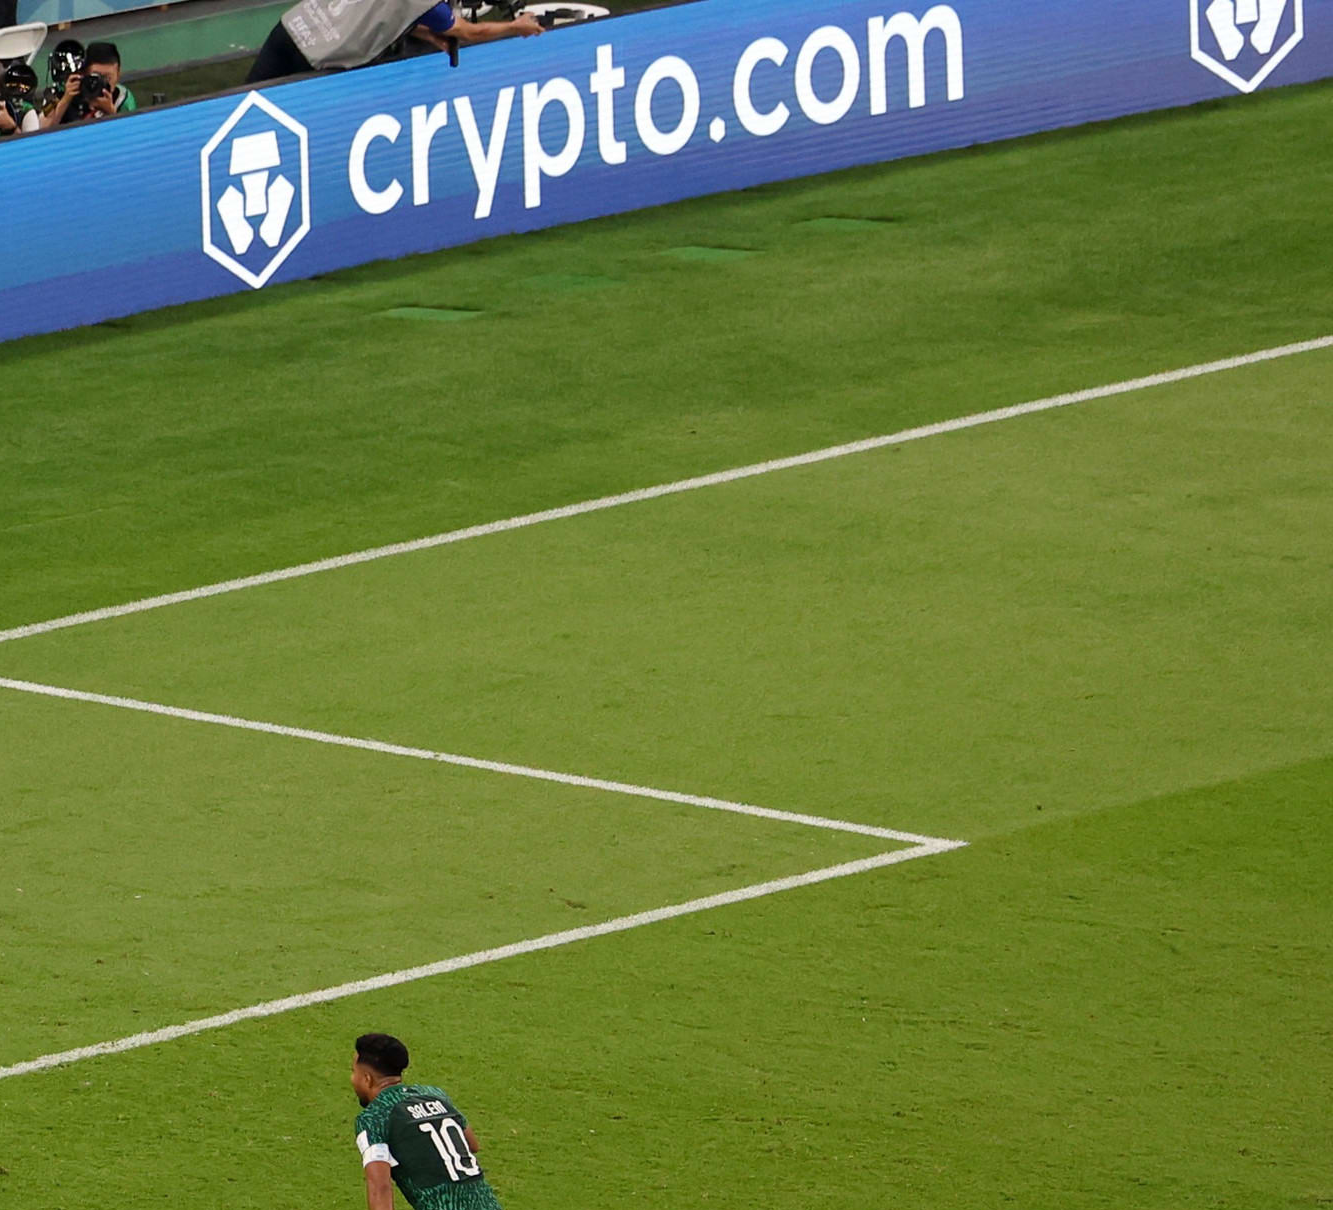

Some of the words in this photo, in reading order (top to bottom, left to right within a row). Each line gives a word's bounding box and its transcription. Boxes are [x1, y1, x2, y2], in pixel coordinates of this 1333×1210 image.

[348, 4, 964, 220] crypto.com
[407, 1100, 449, 1119] SALEM
[418, 1117, 481, 1182] 10
